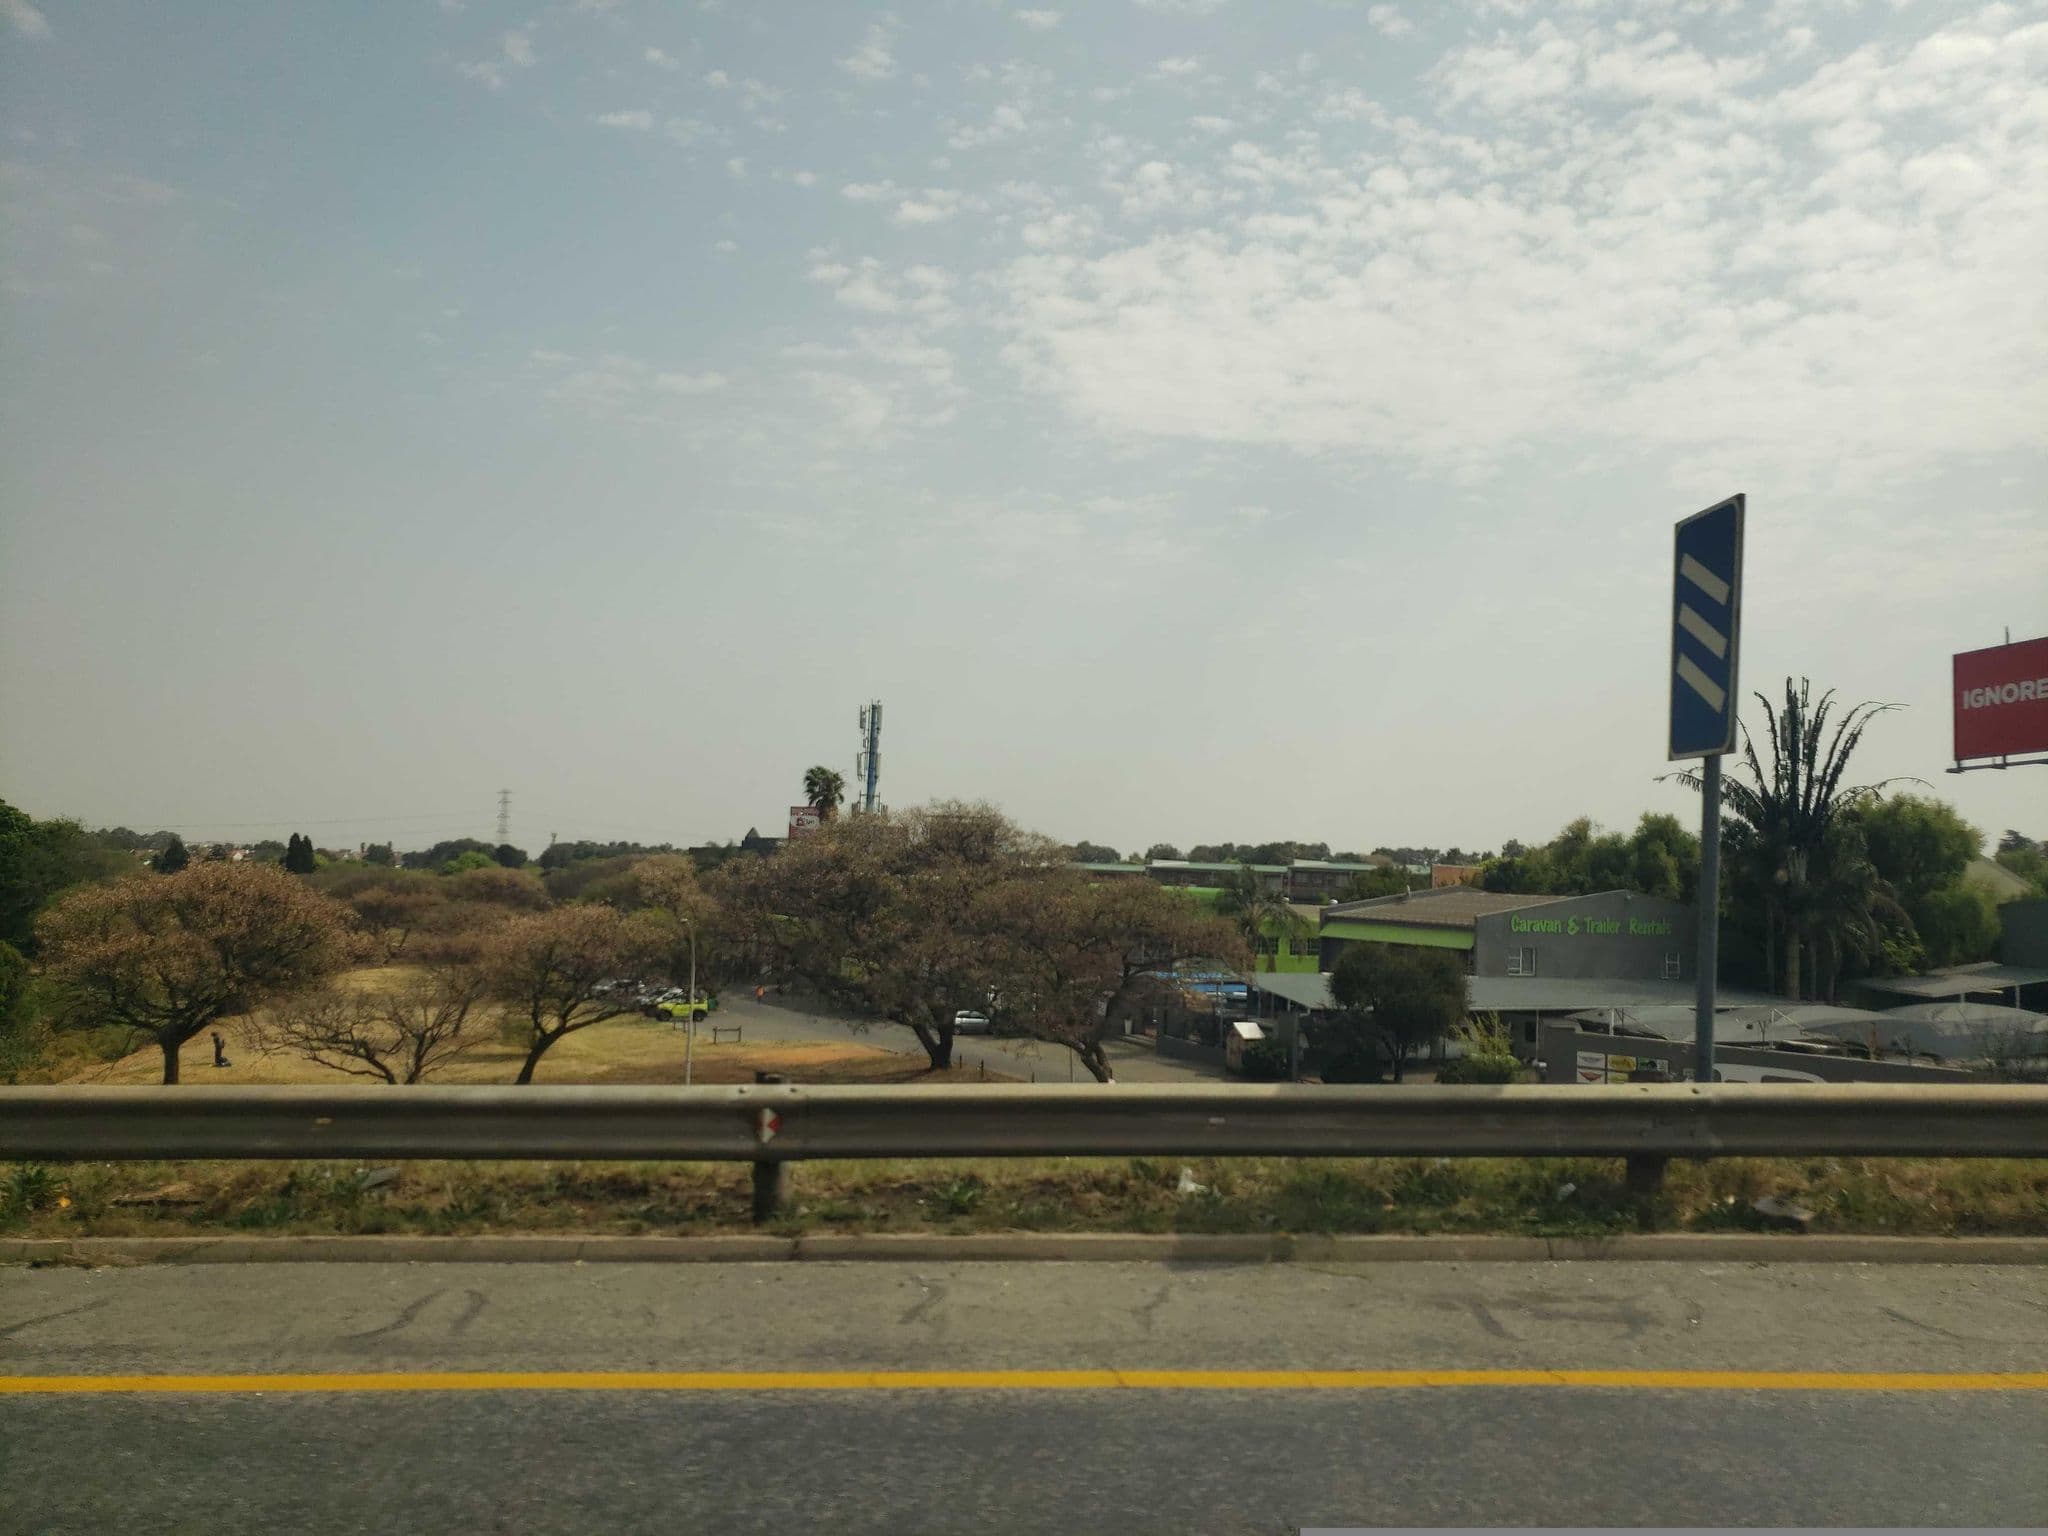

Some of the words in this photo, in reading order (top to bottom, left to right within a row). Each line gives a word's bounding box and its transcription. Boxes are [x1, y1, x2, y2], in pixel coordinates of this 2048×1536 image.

[1963, 678, 2048, 710] IGNORE
[1511, 914, 1562, 934] Caravan
[1567, 915, 1580, 936] &
[1584, 916, 1621, 934] Trailer
[1629, 916, 1673, 936] Rentals
